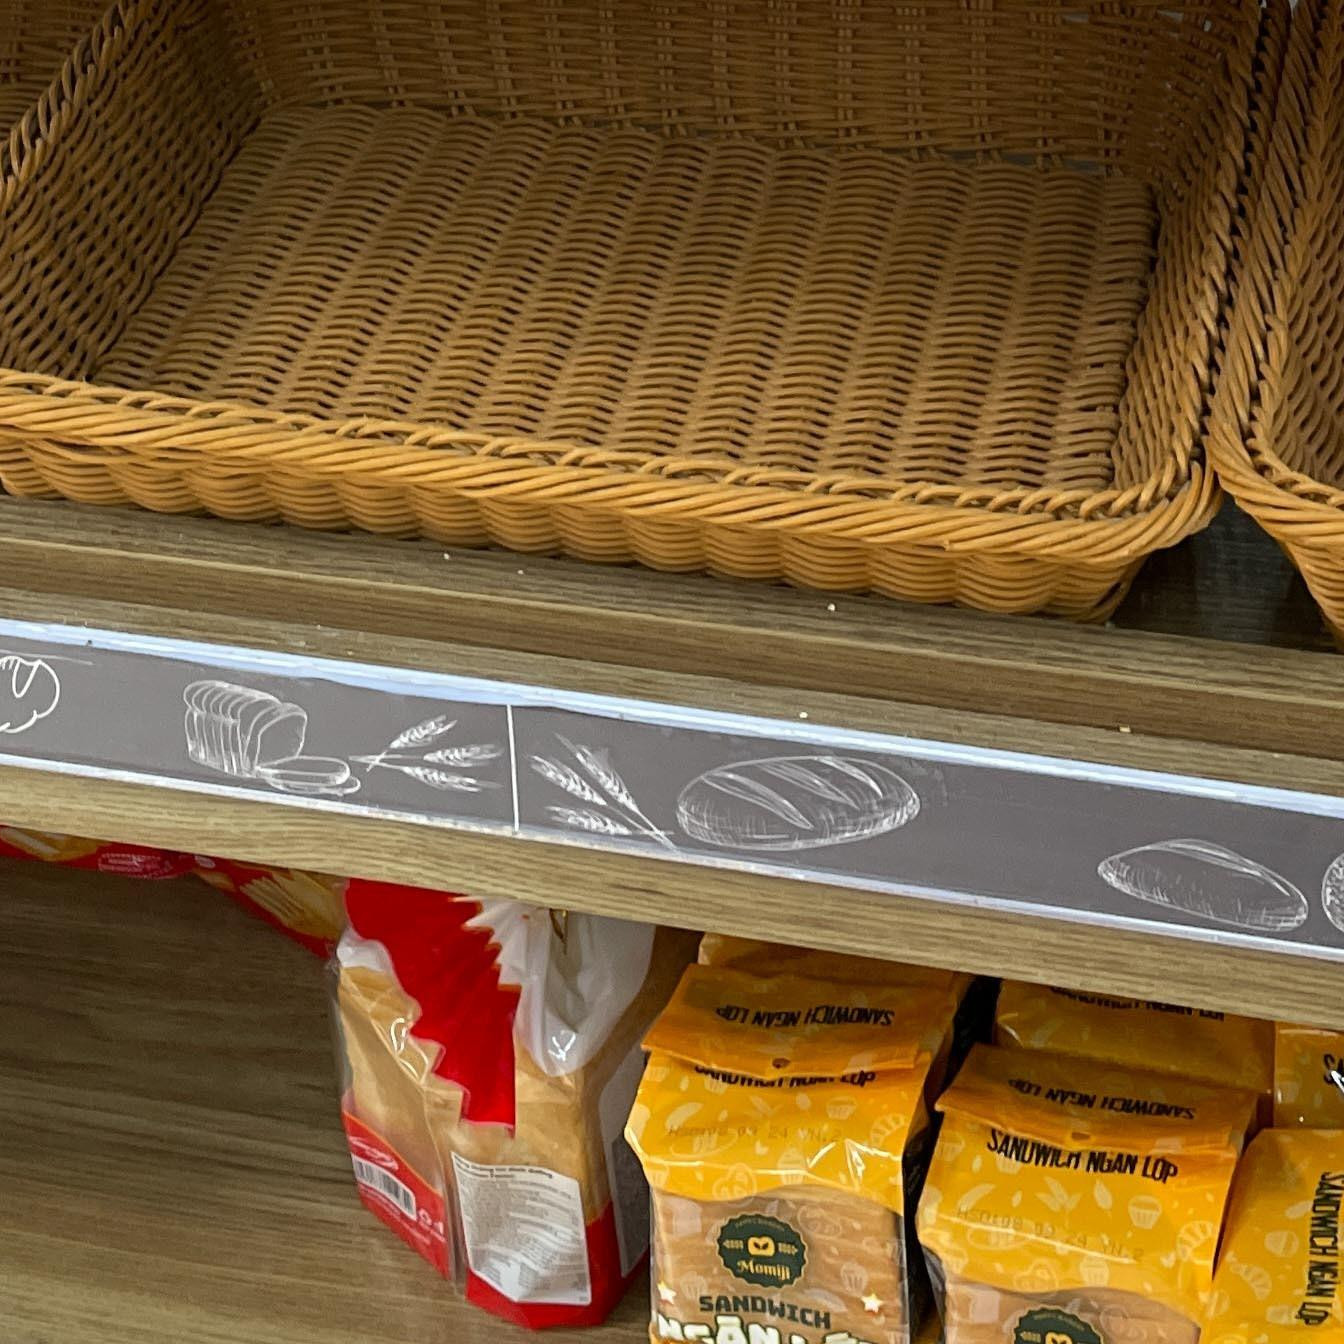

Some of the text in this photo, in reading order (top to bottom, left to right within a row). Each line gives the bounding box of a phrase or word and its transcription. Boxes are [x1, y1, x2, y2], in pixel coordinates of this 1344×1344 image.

[806, 1005, 895, 1026] SANDWICH
[1101, 1096, 1197, 1120] SANDWICH
[699, 1295, 831, 1330] SANDWICH
